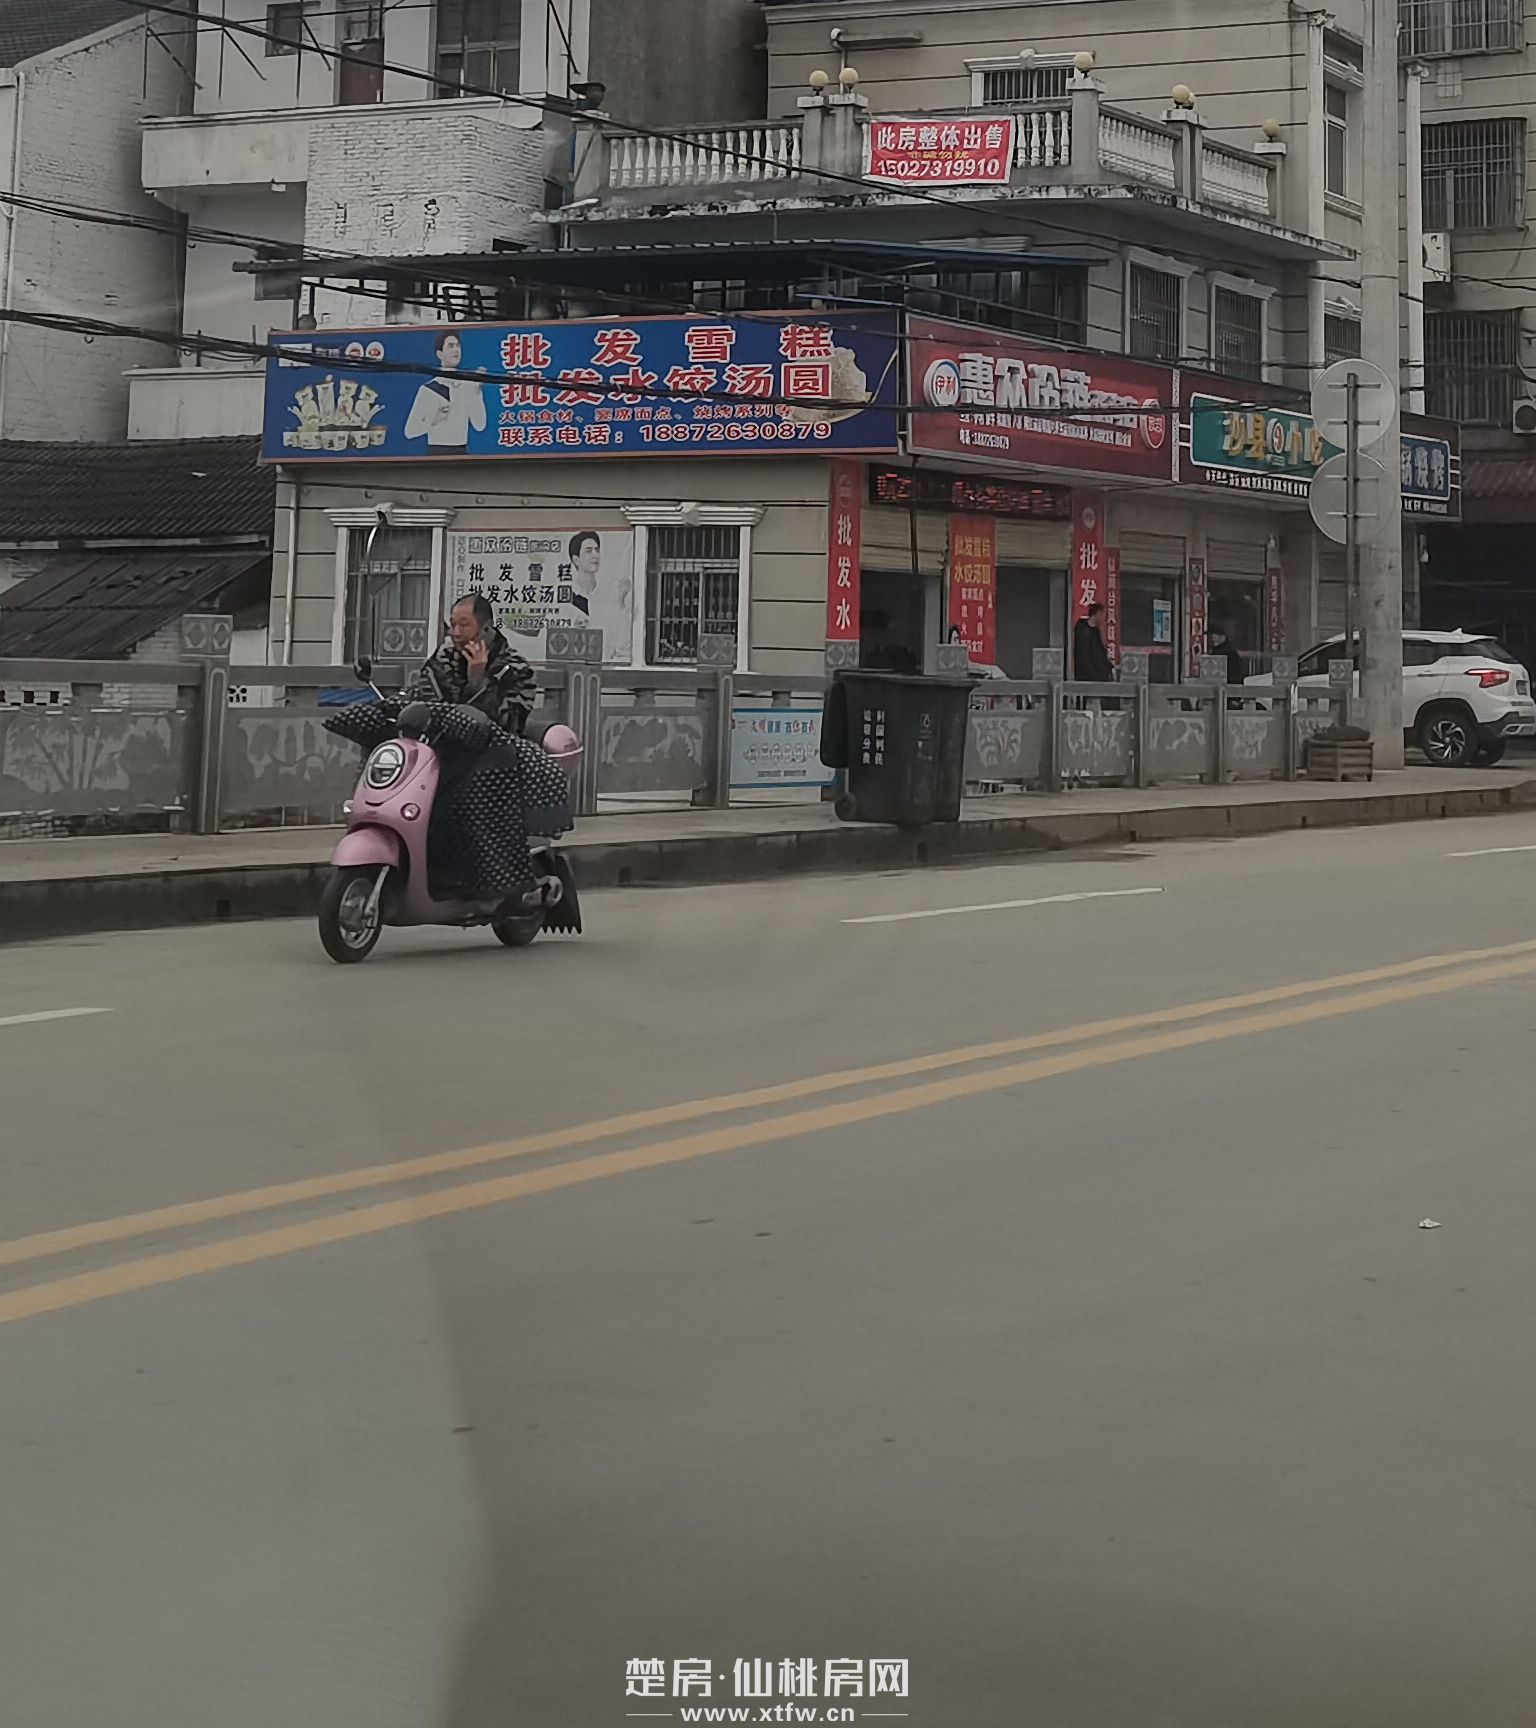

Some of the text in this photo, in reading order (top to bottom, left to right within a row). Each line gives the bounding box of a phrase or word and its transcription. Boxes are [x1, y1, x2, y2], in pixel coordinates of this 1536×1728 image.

[877, 124, 1004, 150] 此房整体出售
[877, 158, 1001, 177] 15027319910
[501, 324, 834, 370] 批发雪糕
[500, 362, 833, 407] 批发水饺汤圆
[639, 422, 833, 443] 18872630879
[469, 562, 573, 583] 批发雪糕
[1079, 542, 1099, 619] 批发
